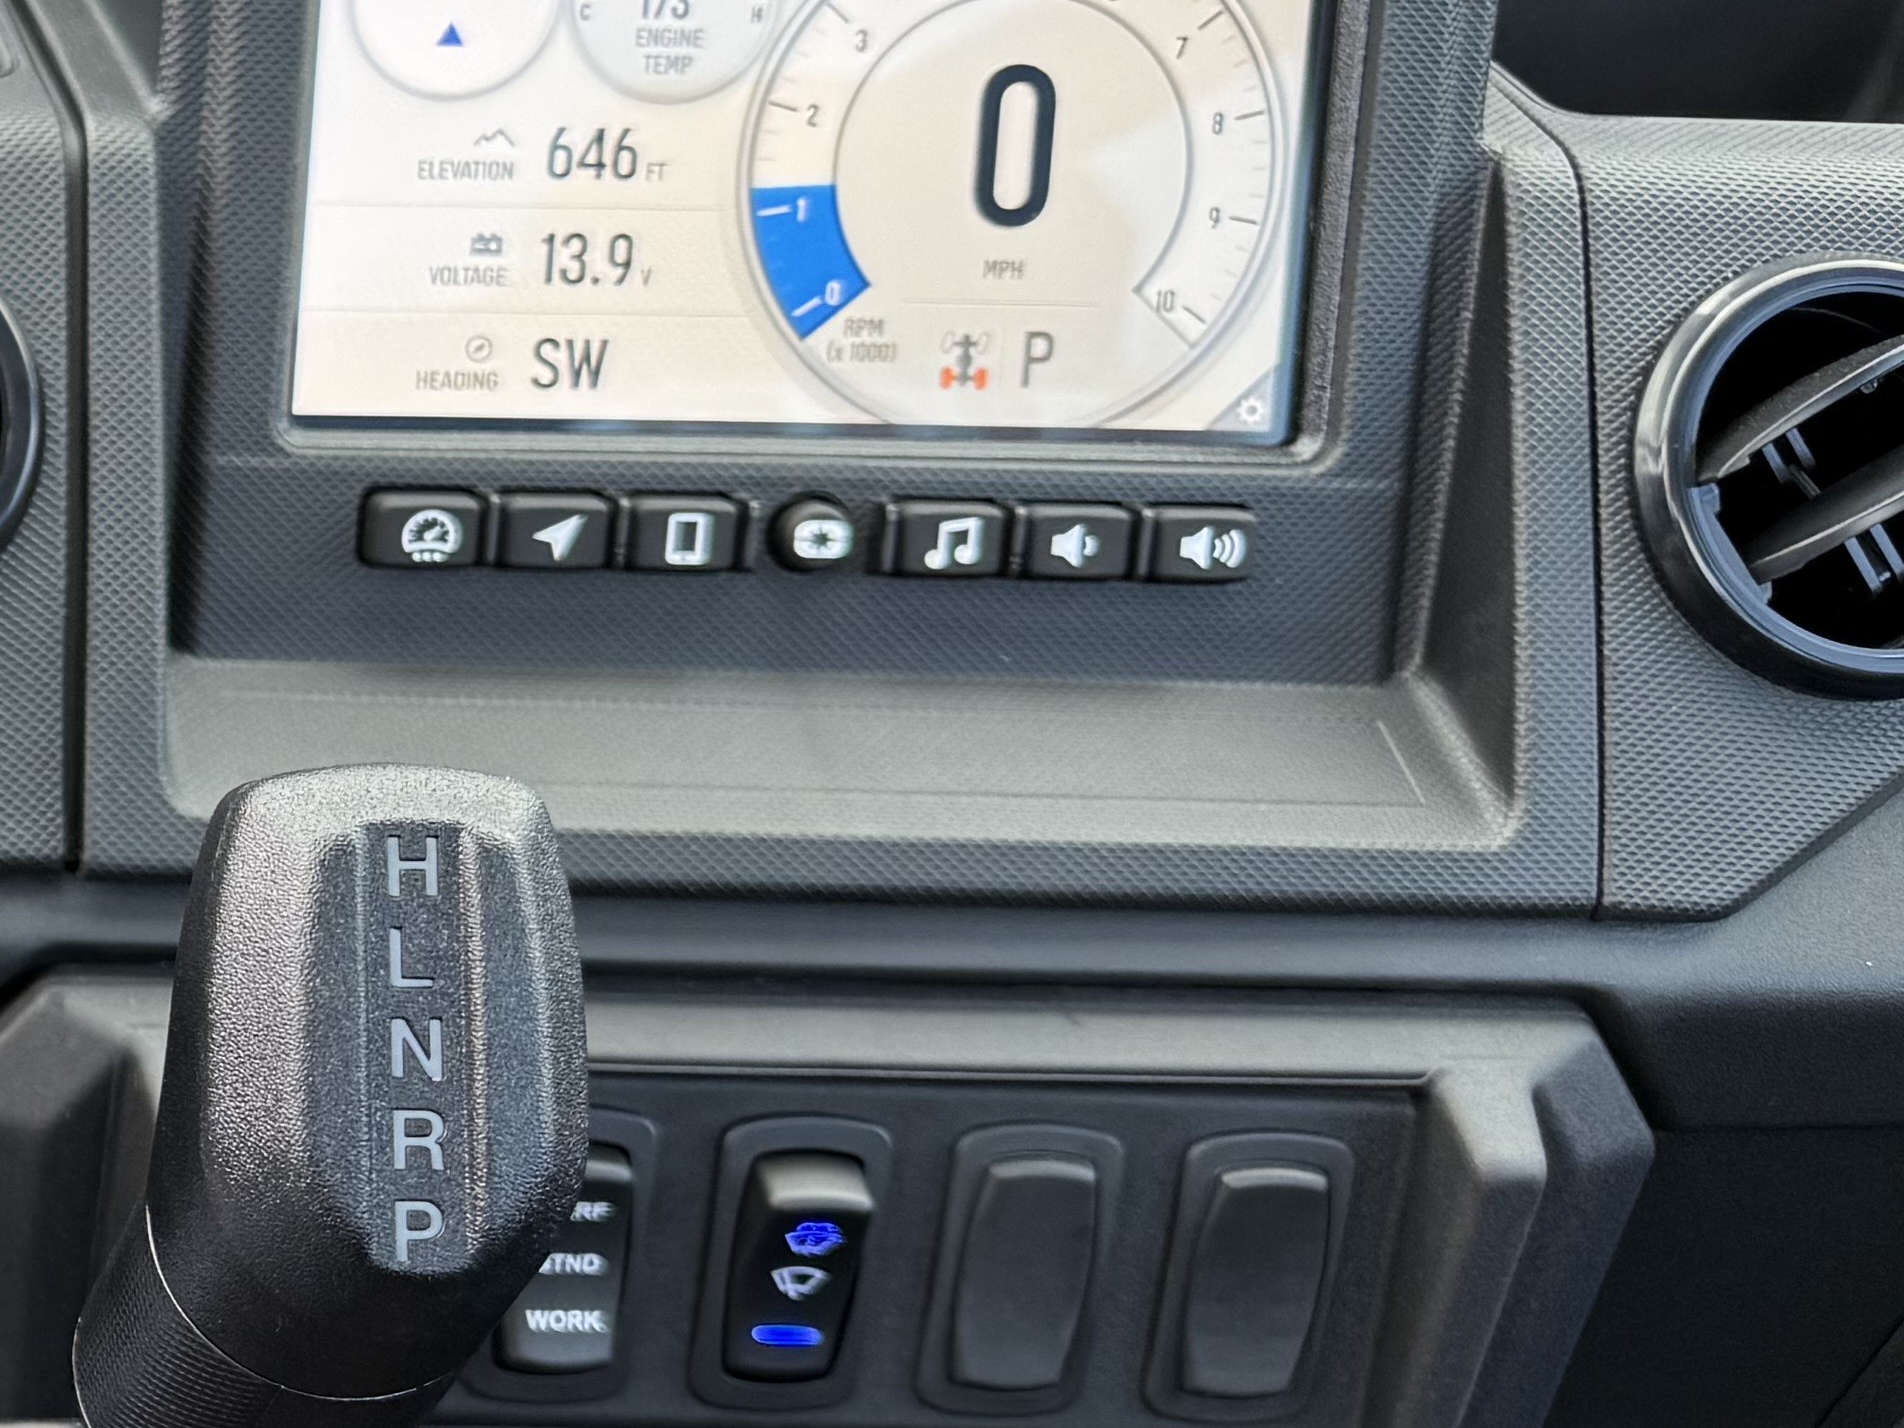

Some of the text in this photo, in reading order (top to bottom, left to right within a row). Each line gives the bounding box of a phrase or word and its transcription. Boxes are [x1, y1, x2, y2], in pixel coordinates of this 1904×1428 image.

[635, 28, 704, 48] ENGINE
[855, 30, 868, 53] 3
[1175, 36, 1189, 60] 7
[643, 55, 694, 75] TEMP
[806, 104, 819, 128] 2
[1212, 111, 1224, 135] 8
[417, 126, 671, 182] ELEVATION 646 FT
[972, 63, 1057, 229] 0
[796, 197, 809, 223] 1
[1209, 206, 1220, 229] 9
[429, 266, 509, 287] VOLTAGE
[541, 233, 634, 286] 13.9
[983, 259, 1026, 280] MPH
[824, 279, 842, 306] 0
[1155, 290, 1175, 314] 10
[844, 317, 885, 338] RPM
[415, 337, 610, 391] HEADING SW
[1020, 331, 1054, 388] P
[387, 834, 439, 897] H
[389, 925, 434, 989] L
[390, 1017, 444, 1083] N
[392, 1109, 446, 1172] R
[394, 1200, 446, 1263] P
[525, 1309, 609, 1333] WORK
